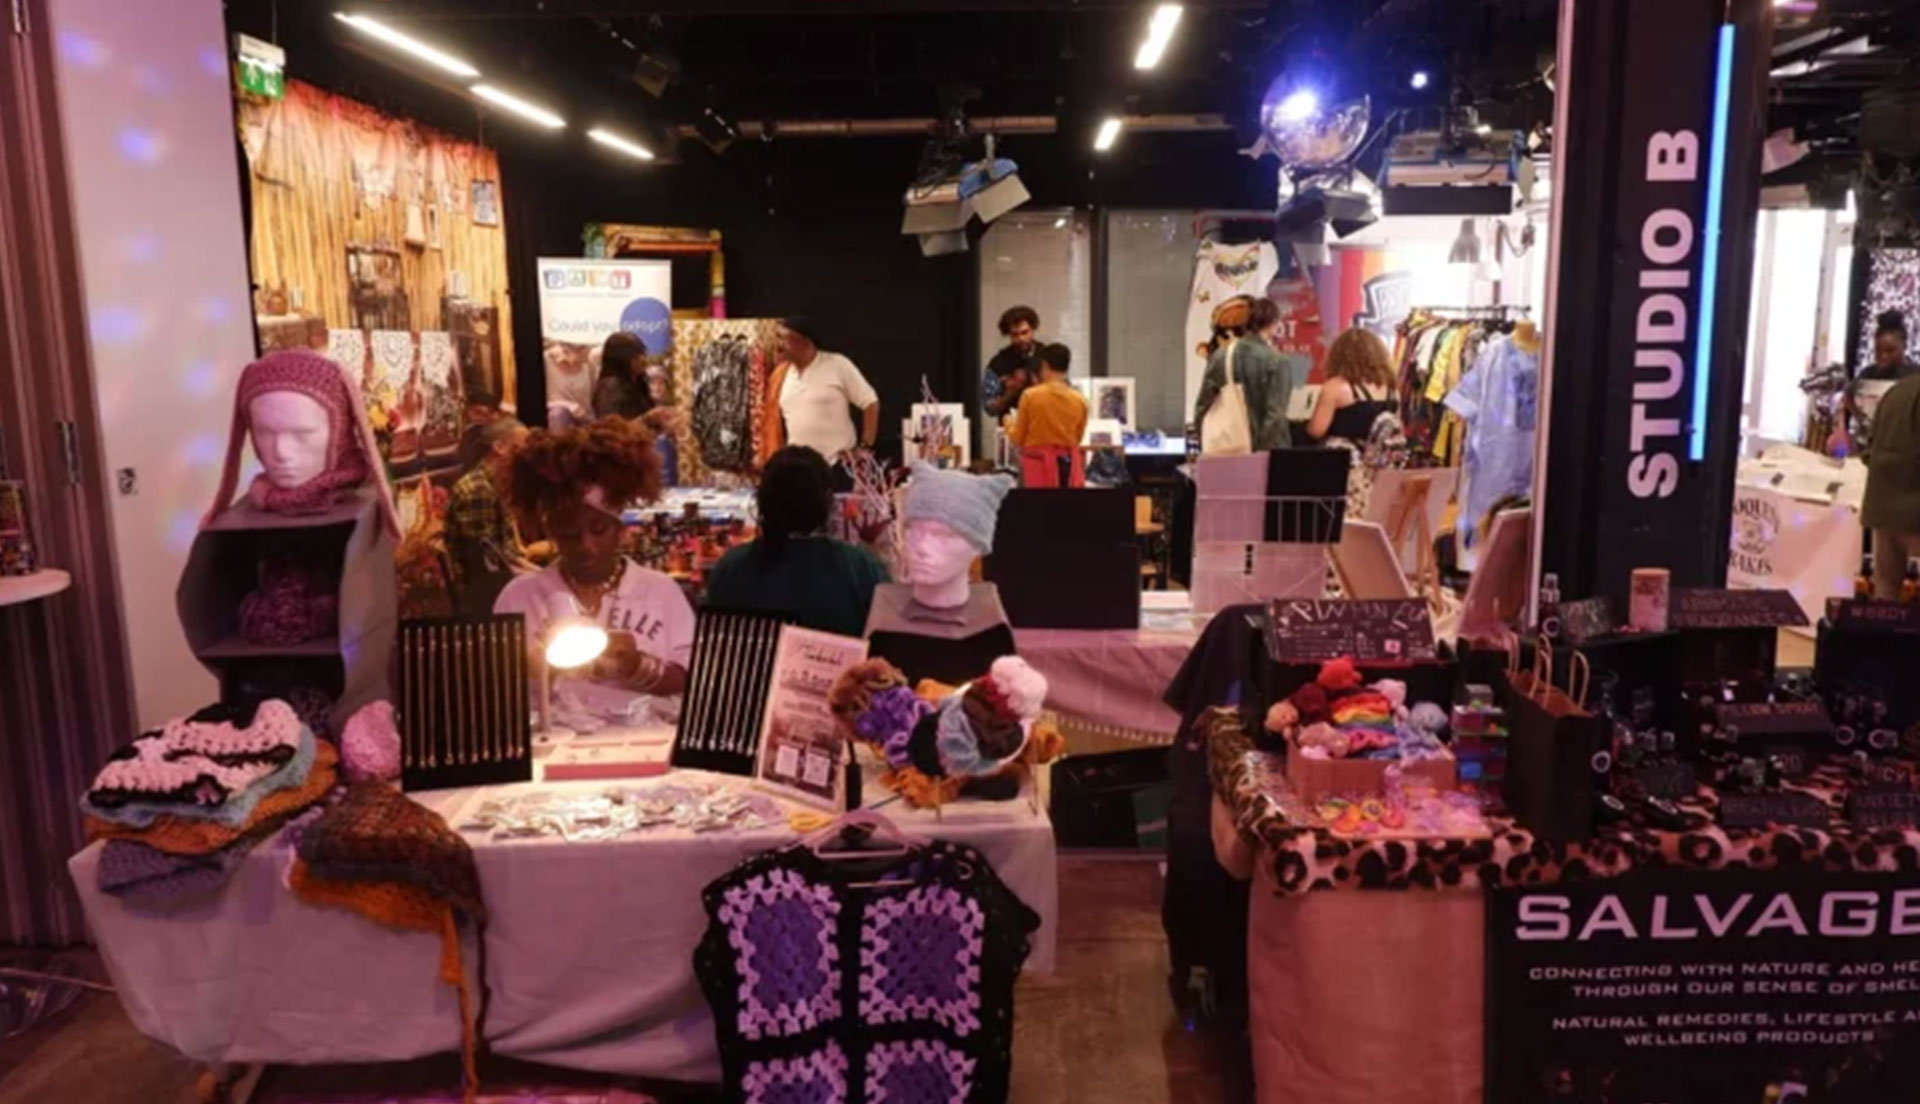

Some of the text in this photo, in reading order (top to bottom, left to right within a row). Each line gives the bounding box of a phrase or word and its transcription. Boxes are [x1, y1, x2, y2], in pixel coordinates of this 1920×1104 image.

[1628, 129, 1700, 498] STUDIO B
[1529, 965, 1673, 980] CONNECTING
[1681, 963, 1734, 977] WITH
[1742, 961, 1830, 976] NATURE
[1839, 961, 1885, 975] AND
[1573, 983, 1680, 998] THROUGH
[1687, 981, 1735, 995] OUR
[1743, 980, 1820, 994] SENSE
[1828, 981, 1858, 995] OF
[1552, 1015, 1648, 1030] NATURAL
[1656, 1013, 1777, 1028] REMEDIES,
[1784, 1011, 1896, 1026] LIFESTYLE
[1623, 1030, 1875, 1047] WELLBEING PRODUCTS
